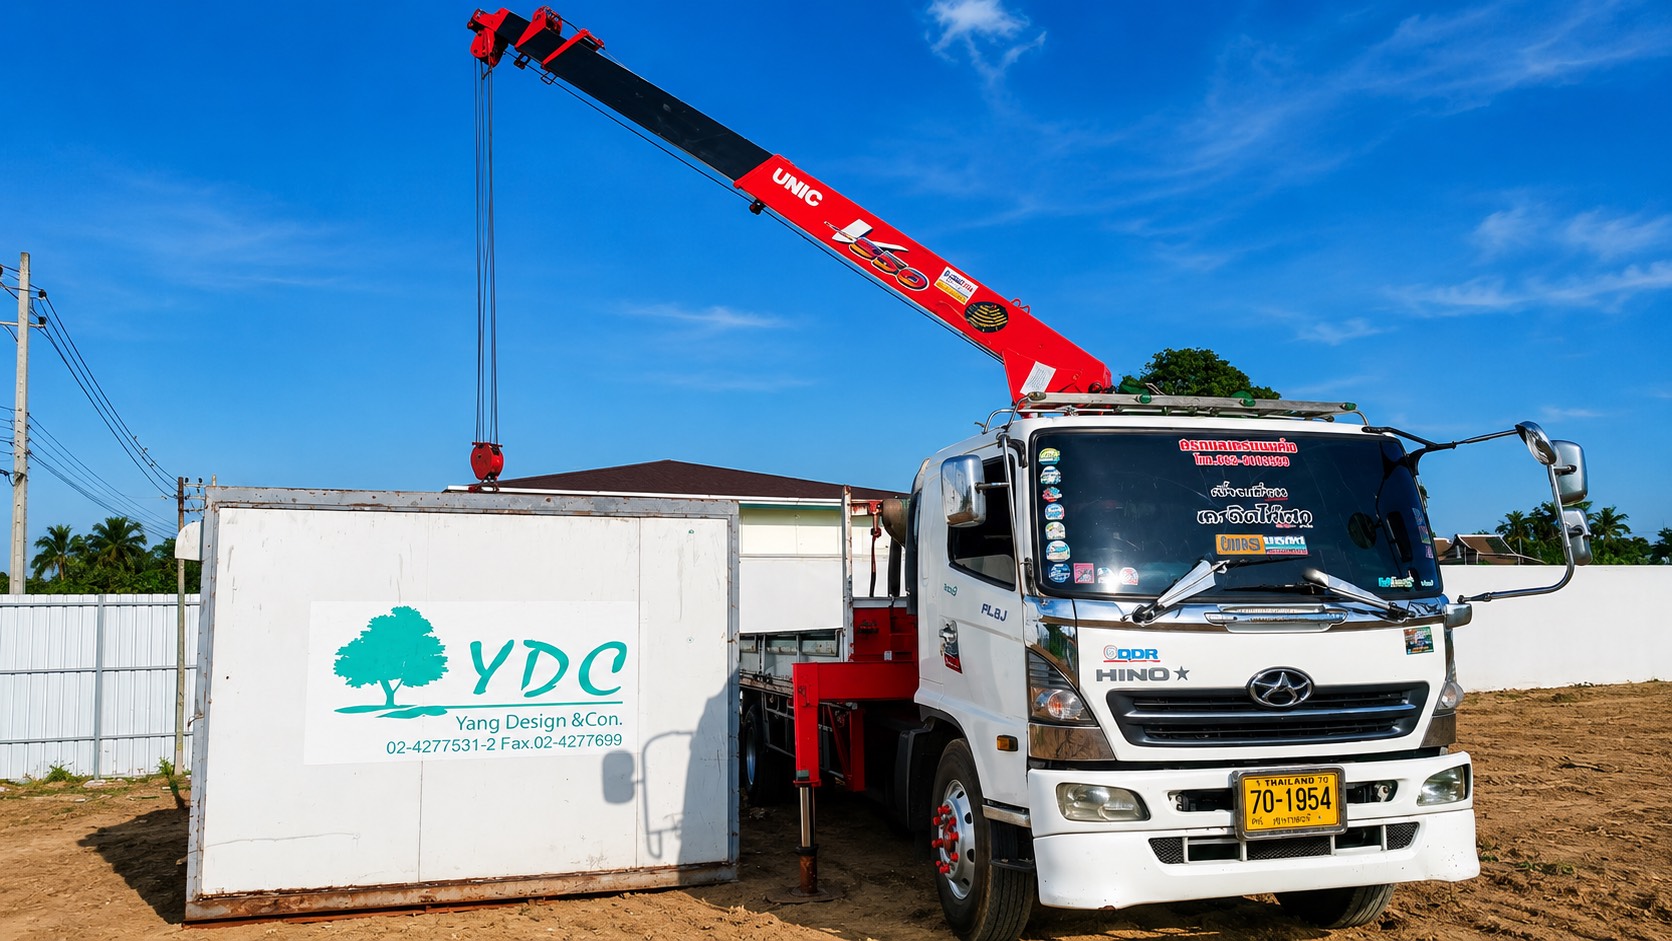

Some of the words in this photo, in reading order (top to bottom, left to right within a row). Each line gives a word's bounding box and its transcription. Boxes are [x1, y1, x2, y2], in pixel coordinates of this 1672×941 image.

[772, 167, 823, 207] UNIC
[469, 639, 628, 698] YDC
[1096, 667, 1170, 682] HINO
[455, 715, 500, 734] Yang
[506, 713, 567, 732] Design
[571, 711, 623, 728] &Con.
[386, 737, 496, 755] 02-4277531-2
[501, 733, 623, 751] Fax.02-4277699
[1264, 777, 1315, 787] THAILAND
[1250, 786, 1332, 815] 70-1954
